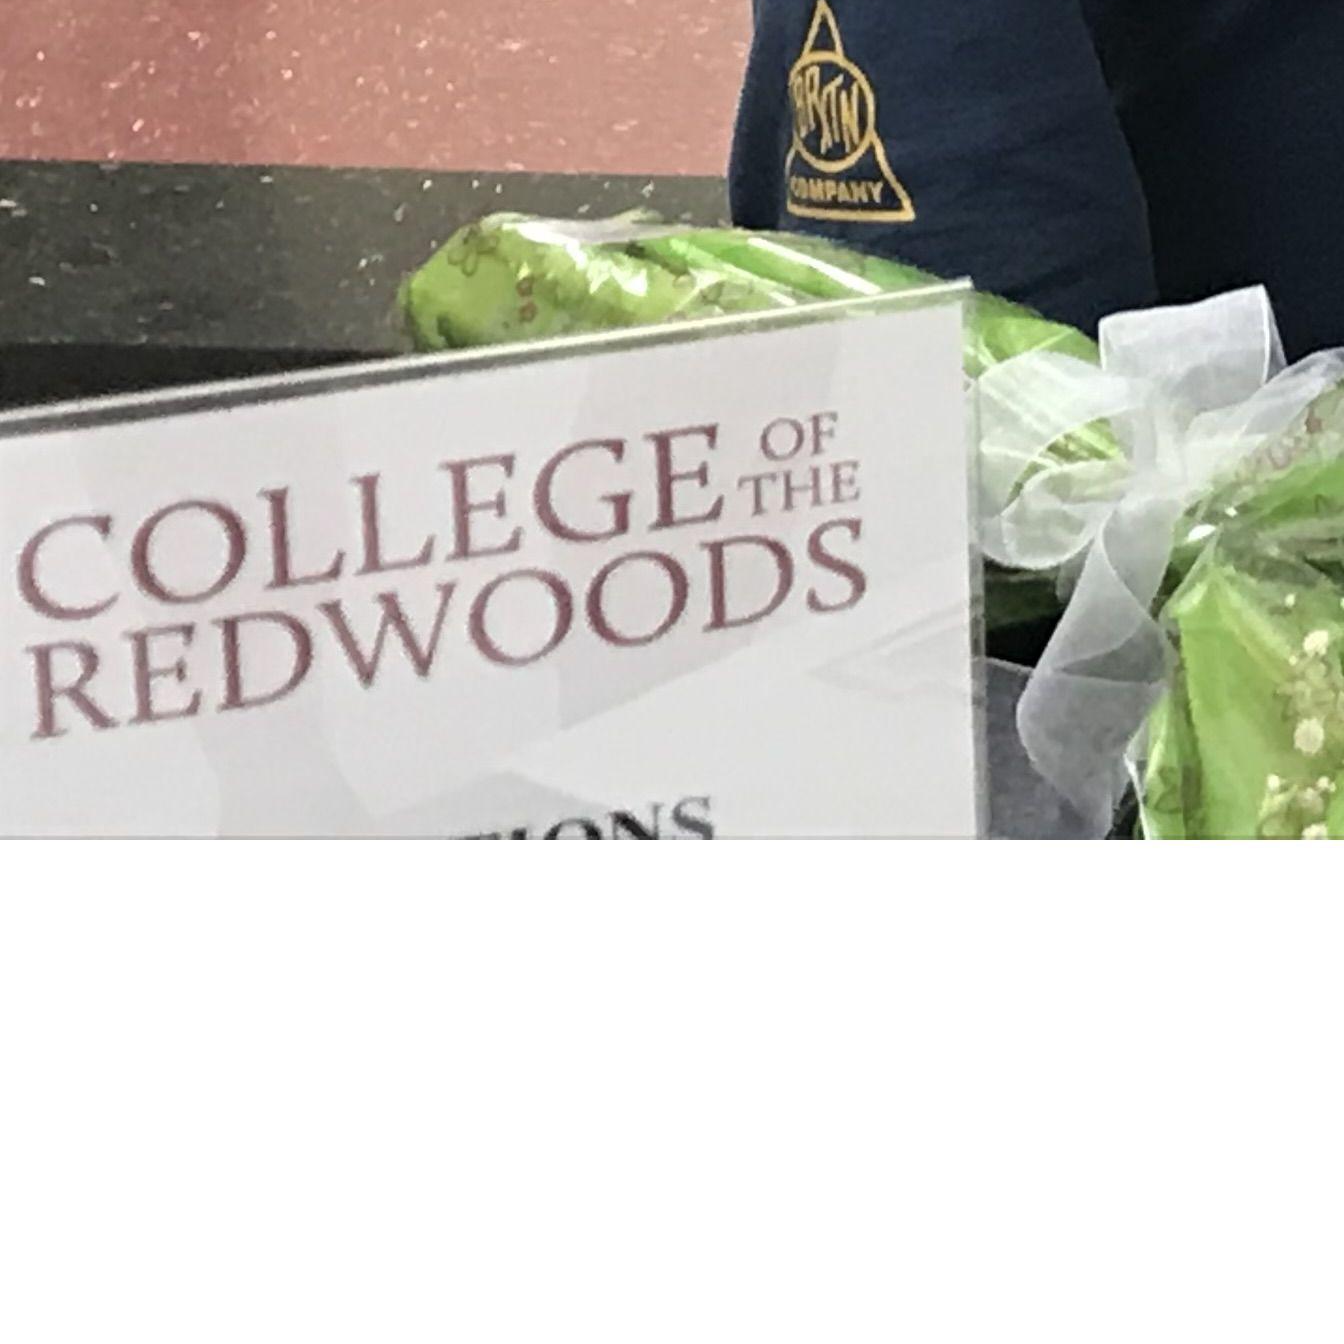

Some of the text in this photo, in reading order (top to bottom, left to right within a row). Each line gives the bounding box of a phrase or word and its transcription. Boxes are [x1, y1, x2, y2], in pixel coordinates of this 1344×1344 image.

[737, 460, 862, 518] THE
[759, 411, 840, 463] OF
[16, 424, 725, 622] COLLEGE
[25, 516, 869, 740] REDWOODS
